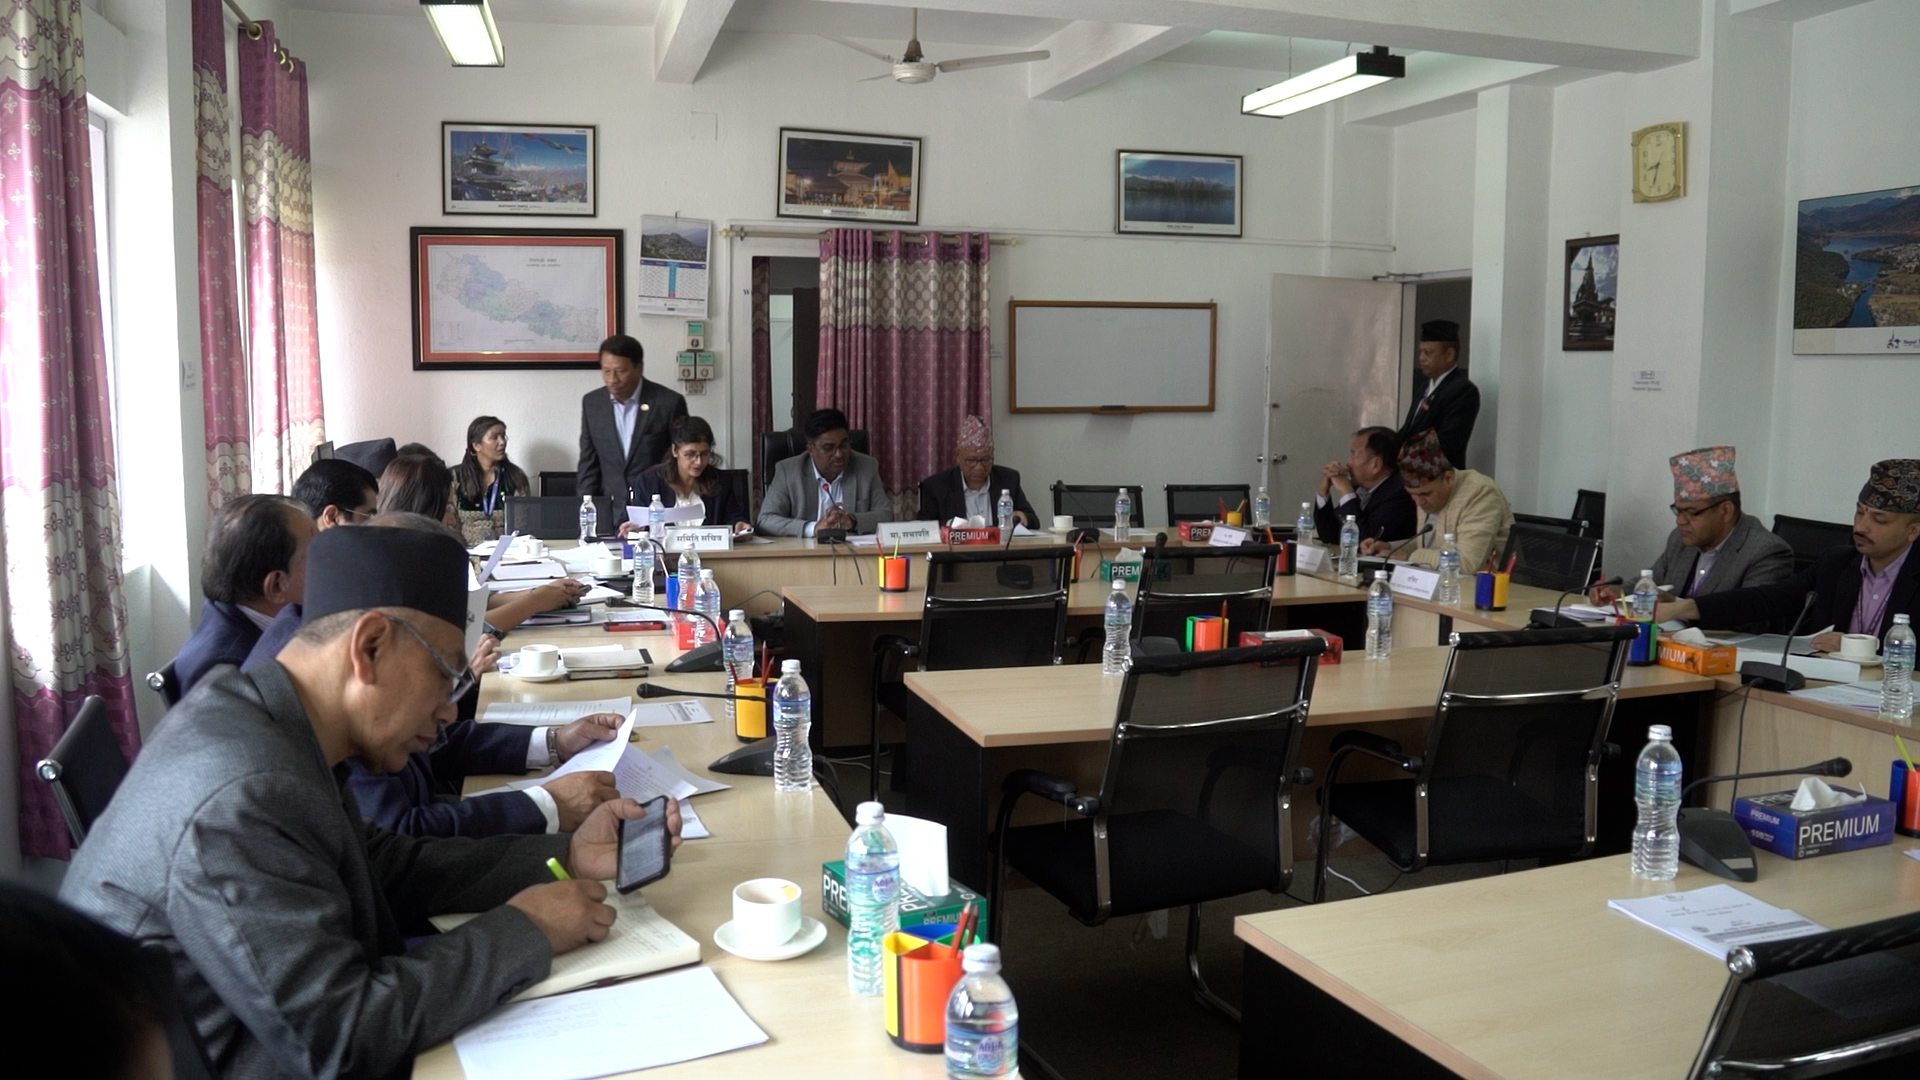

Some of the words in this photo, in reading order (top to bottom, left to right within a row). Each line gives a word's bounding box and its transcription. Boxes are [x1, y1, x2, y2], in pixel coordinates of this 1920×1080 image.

[949, 531, 989, 540] PREMIUM
[1111, 565, 1140, 576] PREM
[1658, 646, 1686, 664] MIUM
[1750, 809, 1780, 825] PREMIUM
[1799, 813, 1880, 846] PREMIUM
[823, 874, 851, 914] PRE
[923, 912, 962, 926] PREMIU
